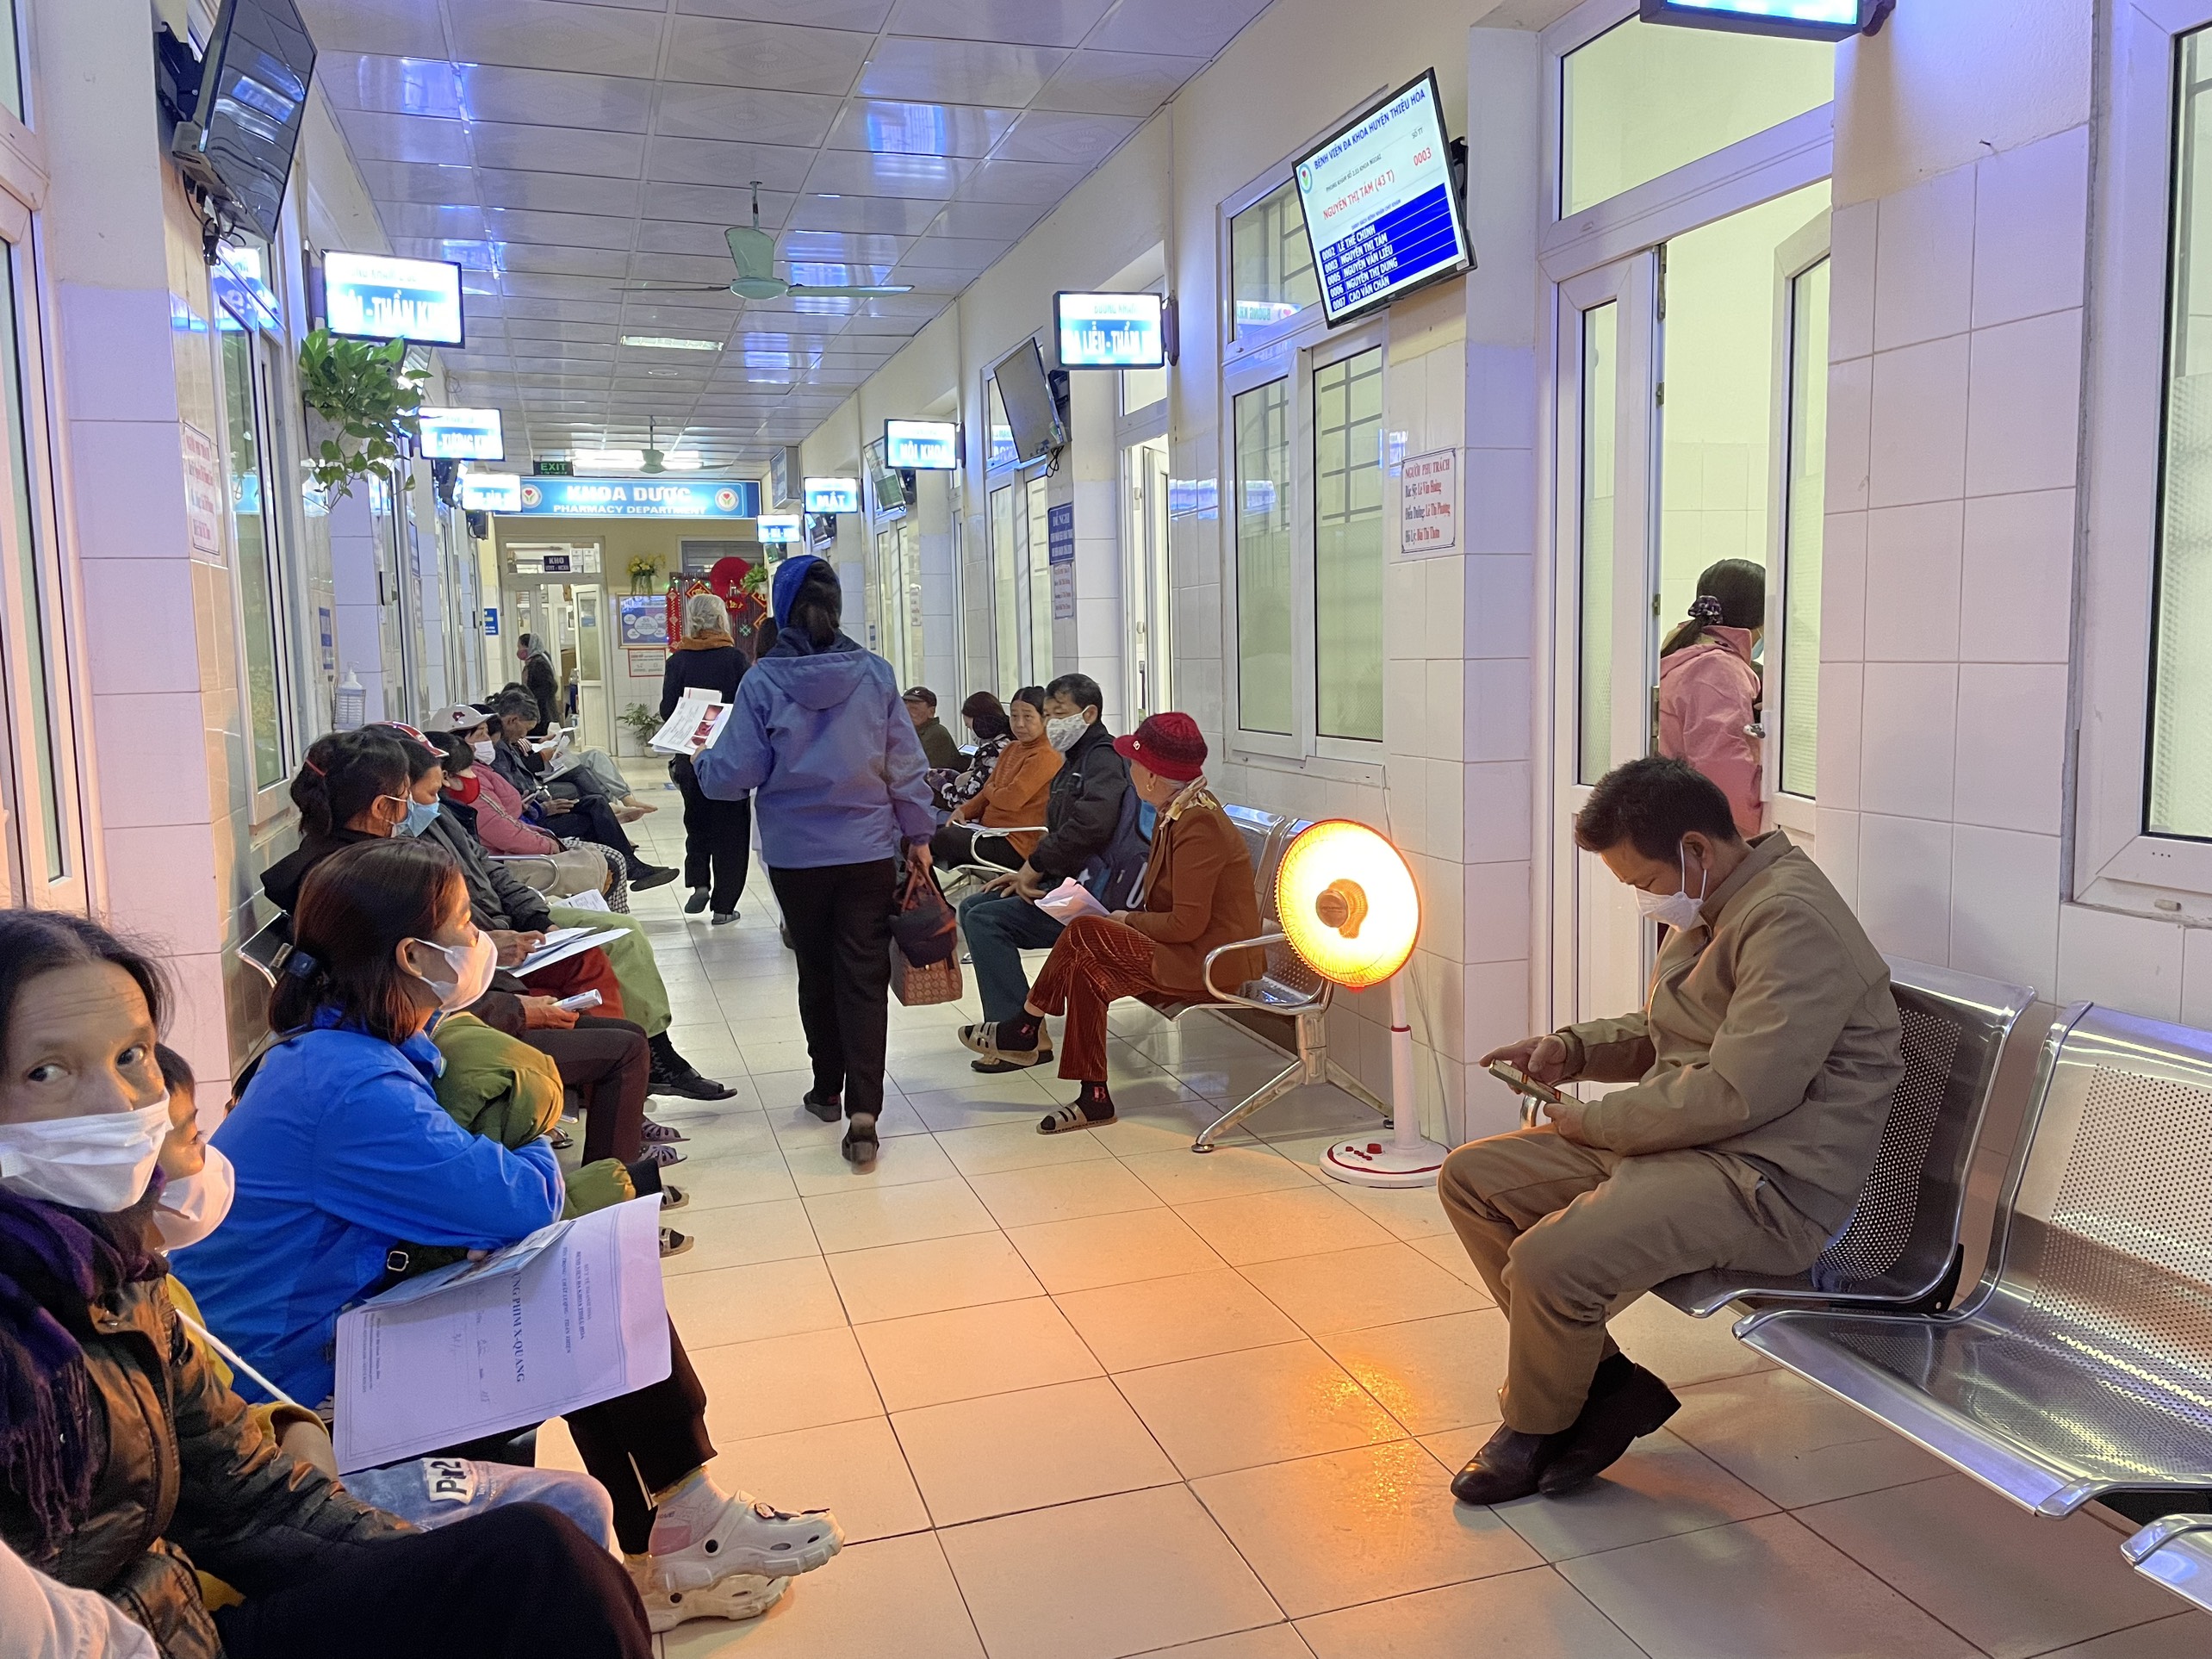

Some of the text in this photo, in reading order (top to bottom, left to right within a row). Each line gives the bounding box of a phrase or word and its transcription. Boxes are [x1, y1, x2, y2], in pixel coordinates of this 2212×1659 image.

[1314, 153, 1328, 169] BỆNH
[1328, 144, 1342, 158] VIỆN
[1343, 138, 1351, 150] ĐA
[1351, 127, 1368, 143] KHOA
[1368, 112, 1389, 133] HUYỆN
[1389, 98, 1409, 118] THIỆU
[1413, 146, 1431, 165] 0003
[1347, 190, 1359, 204] THỊ
[1374, 174, 1385, 191] (43
[1386, 169, 1395, 183] T)
[1321, 246, 1335, 260] 0002
[1324, 258, 1338, 272] 0003
[1340, 245, 1363, 264] NGUYỄN
[1363, 239, 1375, 252] THỊ
[1327, 271, 1340, 285] 0005
[1343, 258, 1366, 276] NGUYỄN
[1345, 271, 1369, 289] NGUYỄN
[1333, 296, 1345, 309] 0007
[1348, 289, 1360, 301] CAO
[1433, 457, 1450, 473] TRÁCH
[566, 485, 692, 505] KHOA DƯỢC
[553, 504, 706, 515] PHARMACY DEPARTMENT
[512, 1298, 522, 1327] PHIM
[513, 1329, 525, 1382] X-QUANG
